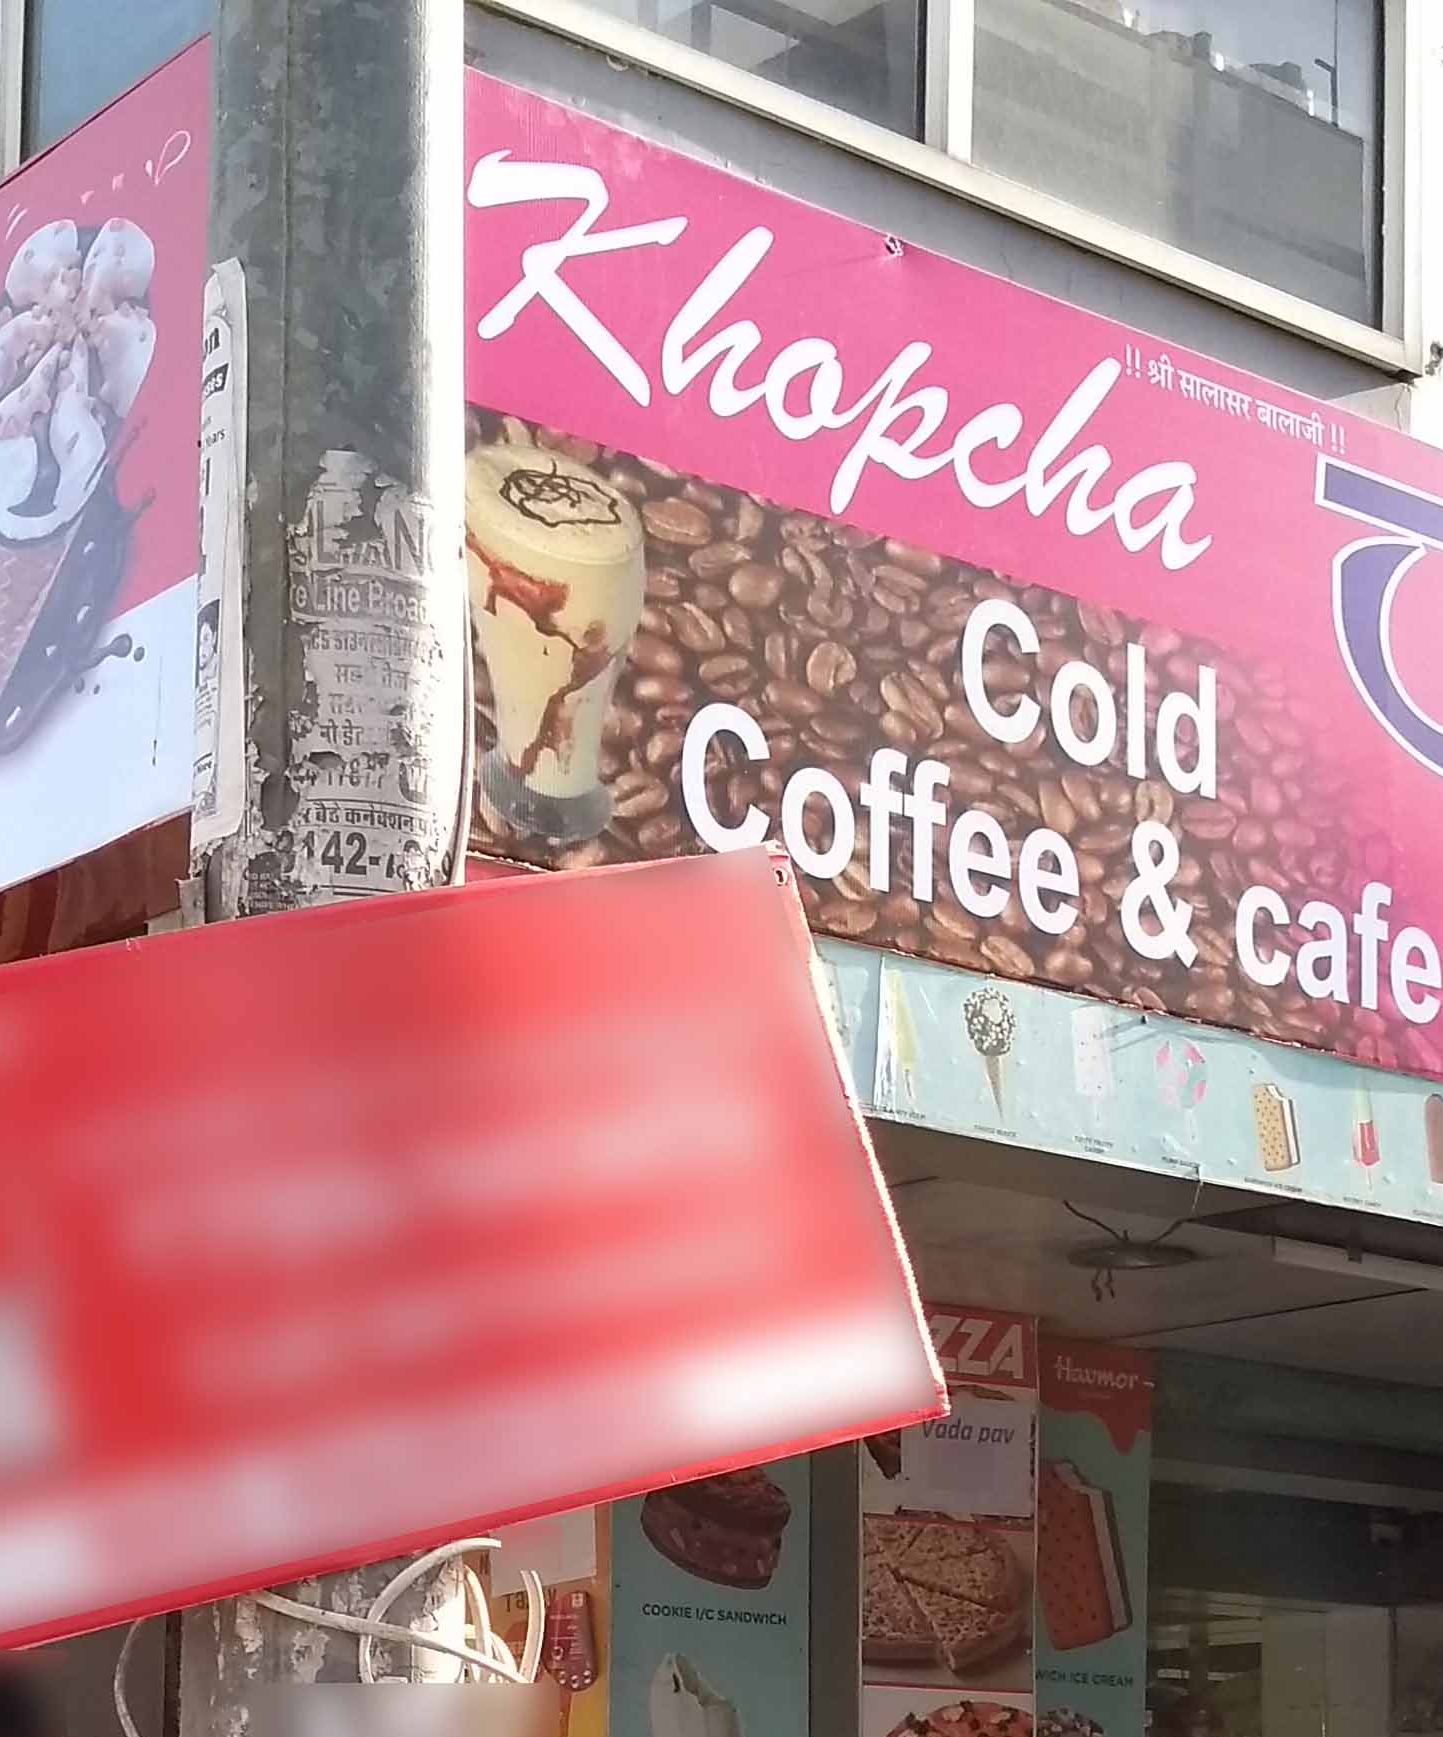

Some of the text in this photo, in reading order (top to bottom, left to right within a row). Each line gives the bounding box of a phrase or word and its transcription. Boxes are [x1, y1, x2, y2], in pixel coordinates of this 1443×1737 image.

[466, 148, 1213, 571] Khopcha
[1148, 355, 1175, 391] श्री
[1177, 369, 1253, 420] सालासर
[1255, 400, 1325, 447] बालाजी
[960, 598, 1218, 801] Cold
[681, 702, 1443, 1025] Coffee & cafe
[926, 1314, 1025, 1380] ZZA
[922, 1418, 1016, 1446] Vada pav
[641, 1603, 692, 1619] COOKIE
[717, 1609, 788, 1626] SANDWICH
[1091, 1675, 1135, 1689] CREAM
